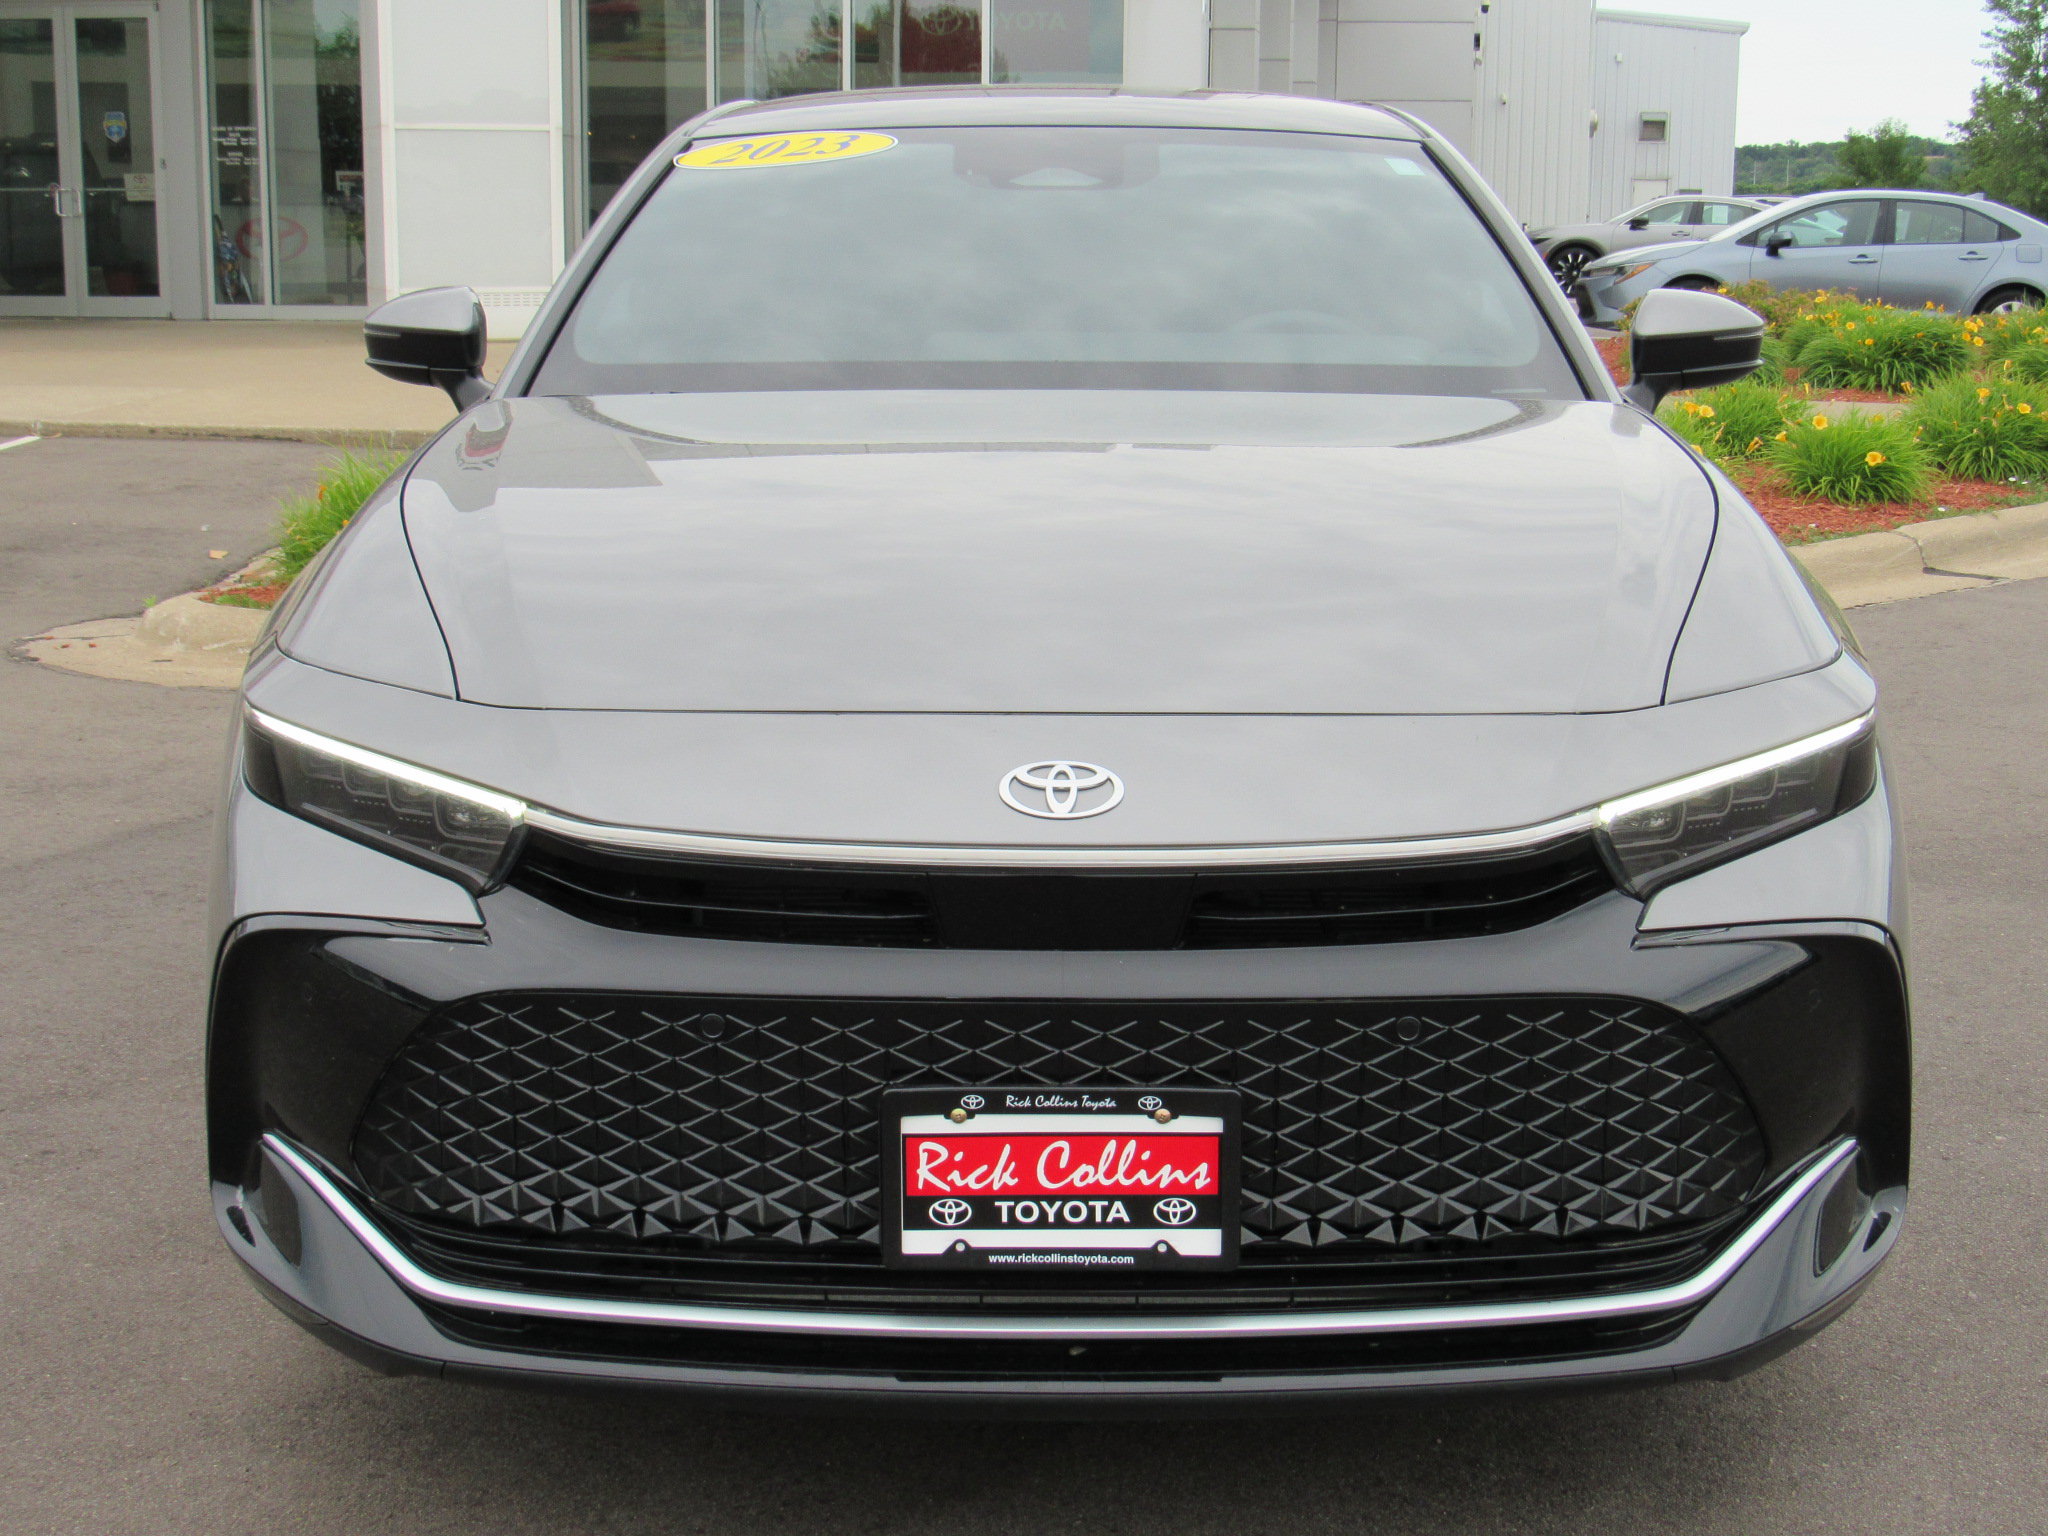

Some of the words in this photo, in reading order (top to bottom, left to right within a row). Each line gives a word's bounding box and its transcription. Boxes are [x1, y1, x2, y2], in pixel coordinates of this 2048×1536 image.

[961, 11, 1066, 31] TYOTA
[708, 134, 860, 165] 2023
[1006, 1095, 1032, 1108] Rick
[1035, 1095, 1079, 1108] Collins
[1081, 1095, 1117, 1110] Toyota
[916, 1141, 1018, 1192] Rick
[1036, 1139, 1211, 1190] Collins
[995, 1201, 1130, 1223] TOYOTA
[988, 1253, 1134, 1266] www.rickcollinstoyota.com
